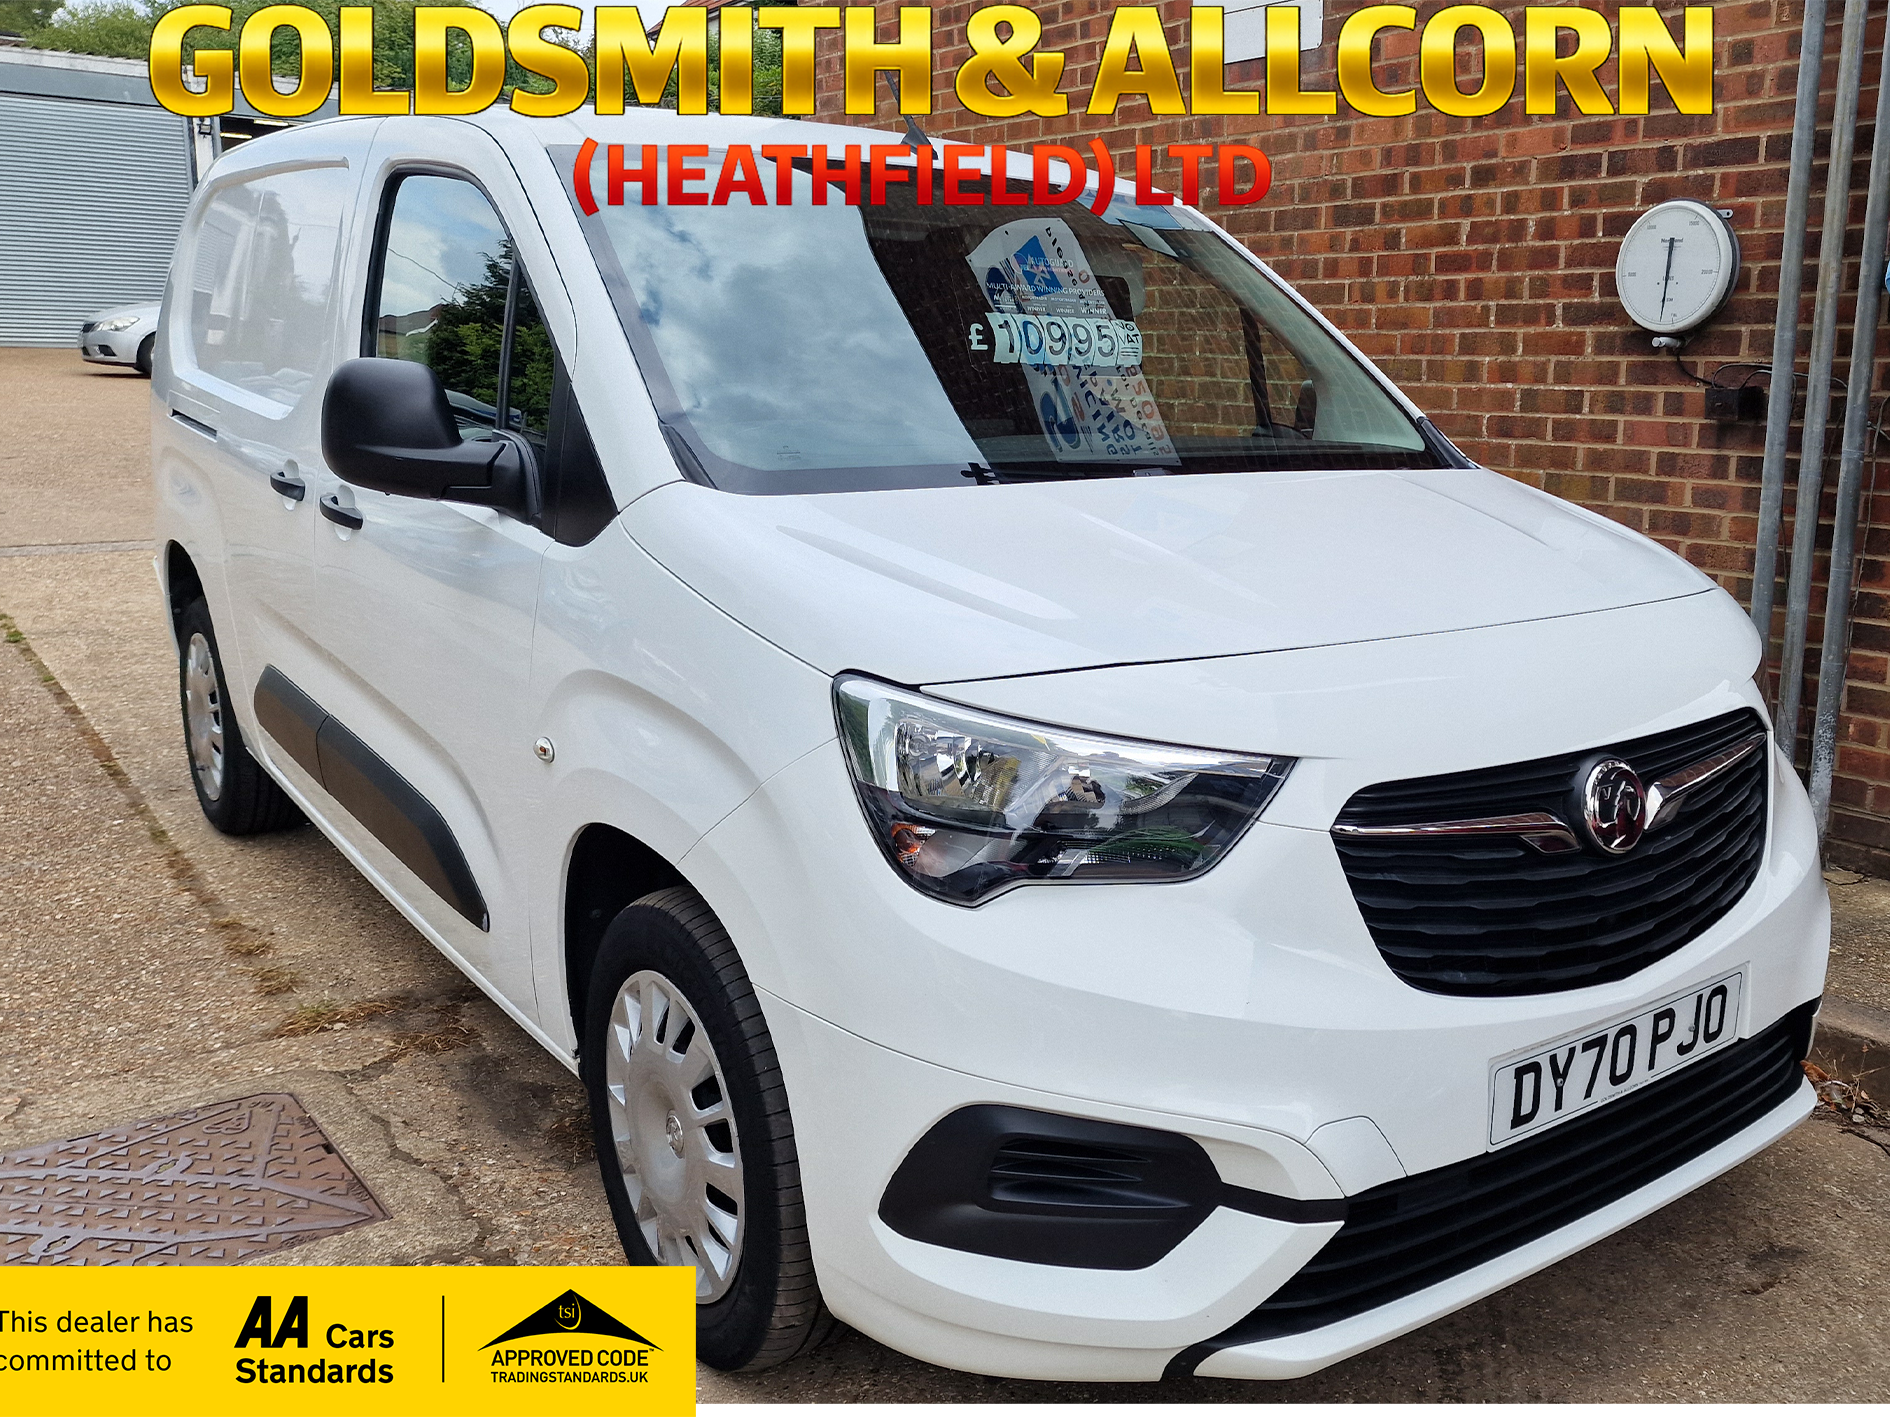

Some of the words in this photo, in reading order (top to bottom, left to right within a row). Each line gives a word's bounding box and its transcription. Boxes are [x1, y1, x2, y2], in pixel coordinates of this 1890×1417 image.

[1118, 333, 1140, 346] VAT
[1510, 1024, 1637, 1130] DY70
[1648, 984, 1728, 1072] PJO
